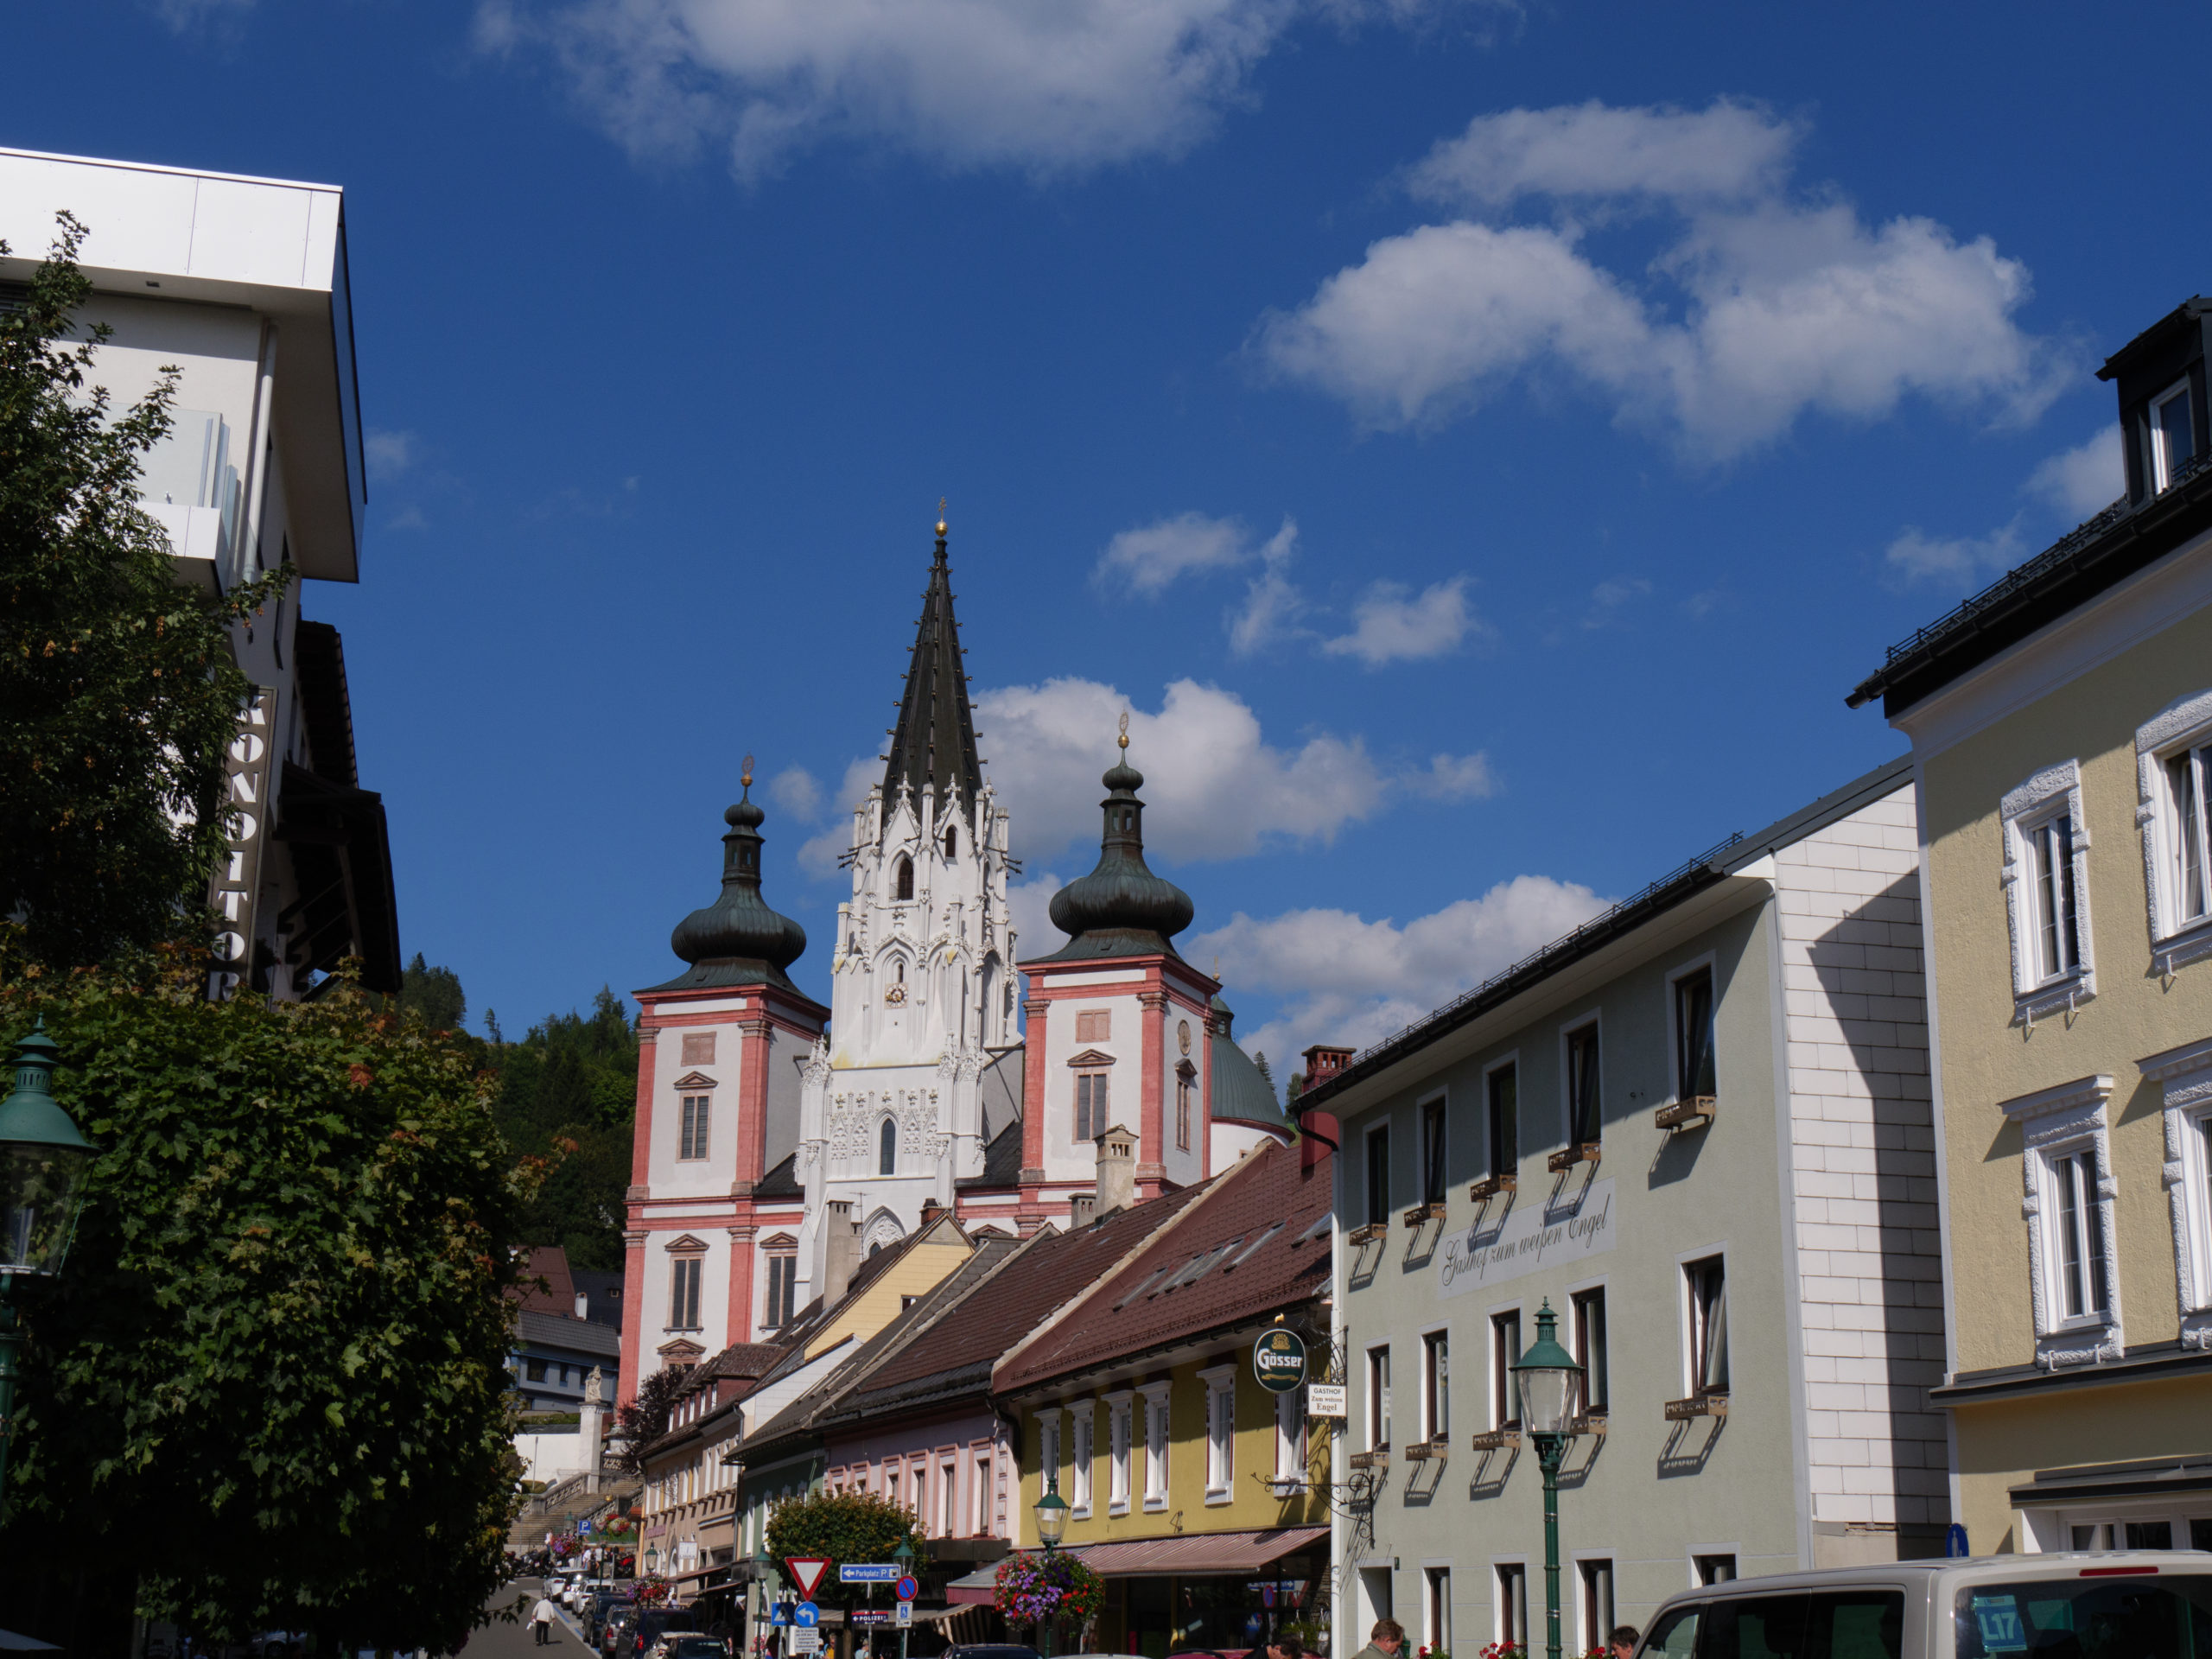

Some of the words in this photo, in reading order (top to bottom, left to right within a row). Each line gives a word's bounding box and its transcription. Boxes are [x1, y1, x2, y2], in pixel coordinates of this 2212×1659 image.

[1442, 1236, 1491, 1286] Gasthof
[1489, 1243, 1516, 1263] zum
[1520, 1221, 1562, 1262] weißen
[1567, 1193, 1611, 1249] Engel
[1257, 1348, 1303, 1371] Gösser
[1316, 1402, 1338, 1413] Engel
[582, 1522, 588, 1531] P
[855, 1569, 879, 1579] Parkplatz
[1980, 1611, 2016, 1640] L17
